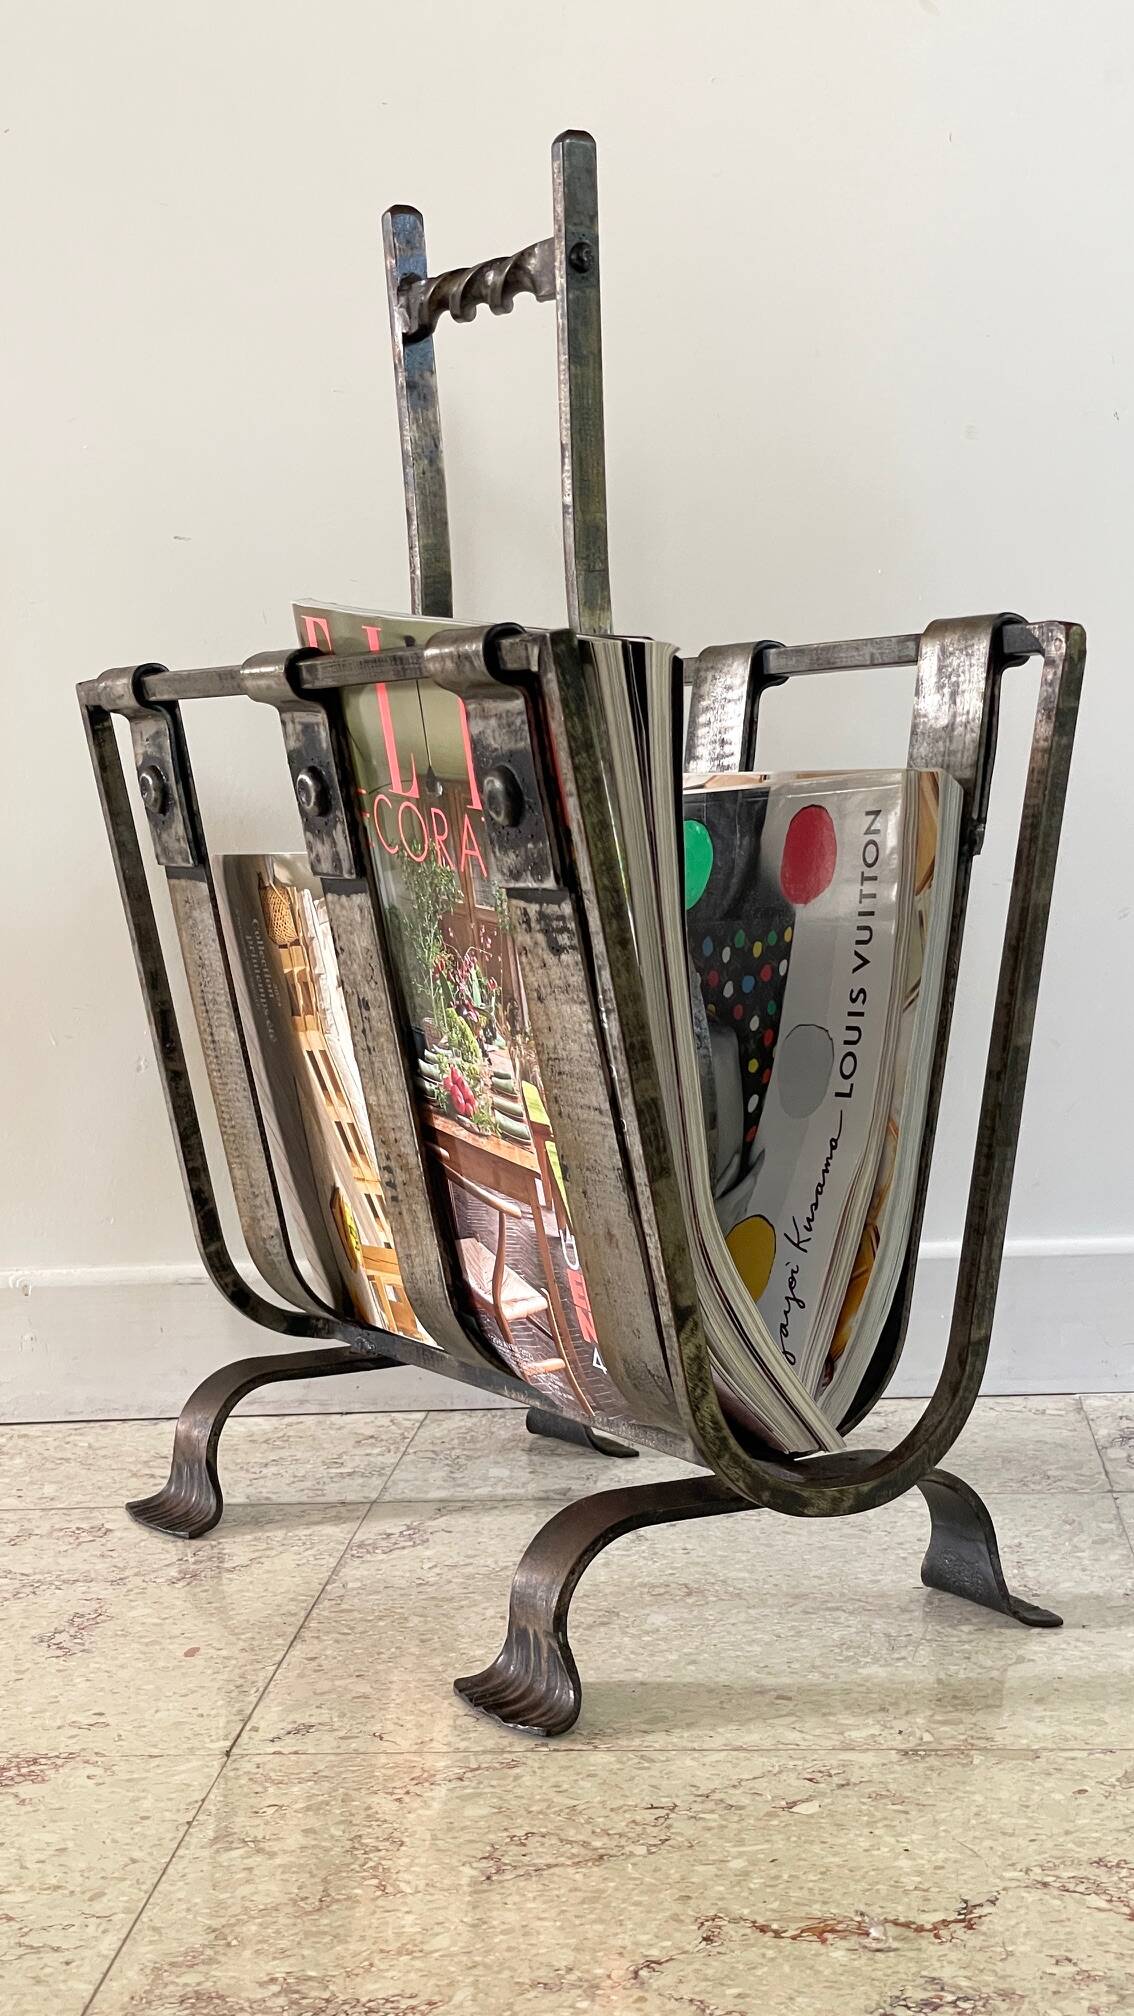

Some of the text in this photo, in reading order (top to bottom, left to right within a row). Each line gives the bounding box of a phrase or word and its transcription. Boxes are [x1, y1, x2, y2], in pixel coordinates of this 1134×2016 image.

[251, 918, 274, 998] Collection
[784, 1109, 843, 1253] Kusama
[834, 986, 867, 1099] LOUIS
[851, 808, 882, 974] VUITTON
